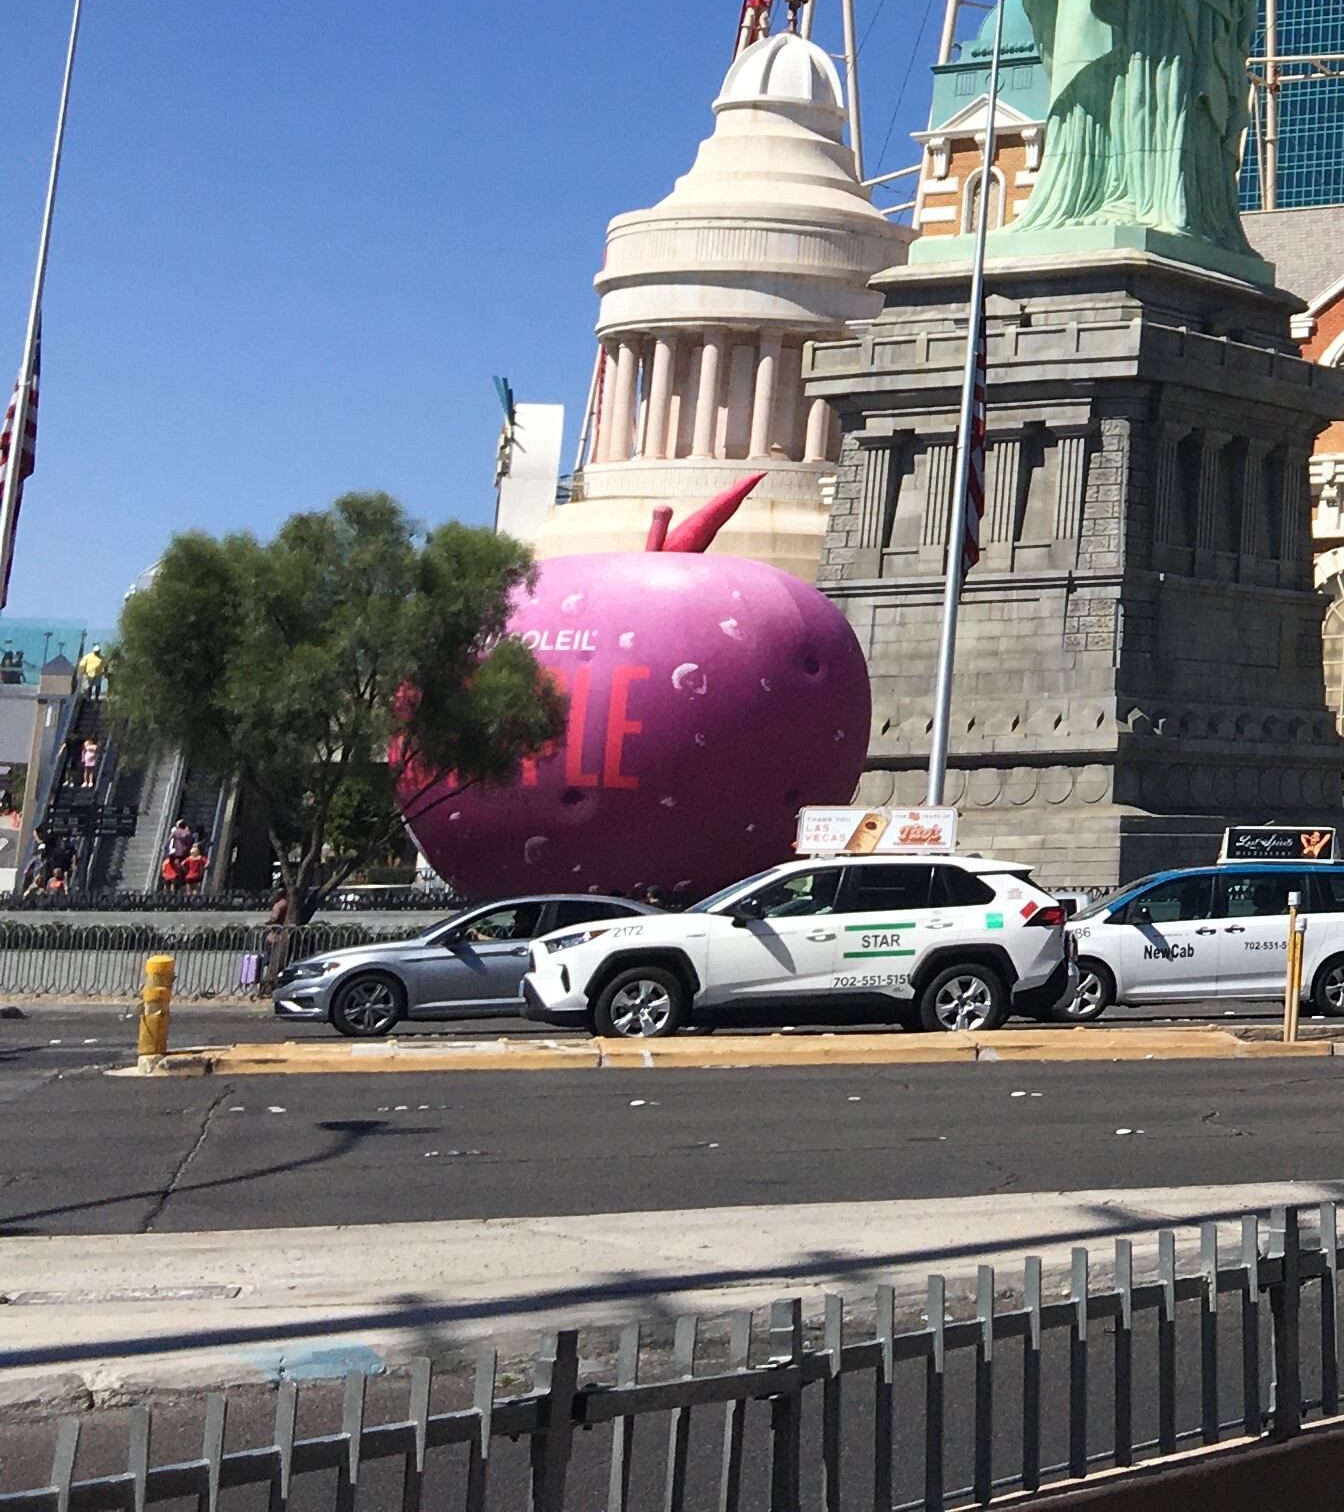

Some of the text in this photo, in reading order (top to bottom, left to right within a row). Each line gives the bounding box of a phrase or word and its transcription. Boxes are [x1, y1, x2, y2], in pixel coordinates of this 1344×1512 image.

[835, 816, 851, 824] YOU
[805, 823, 830, 832] LAS
[804, 833, 847, 842] VEGAS
[613, 925, 644, 938] 2172
[861, 934, 901, 948] STAR
[833, 973, 912, 988] 702-551-5151
